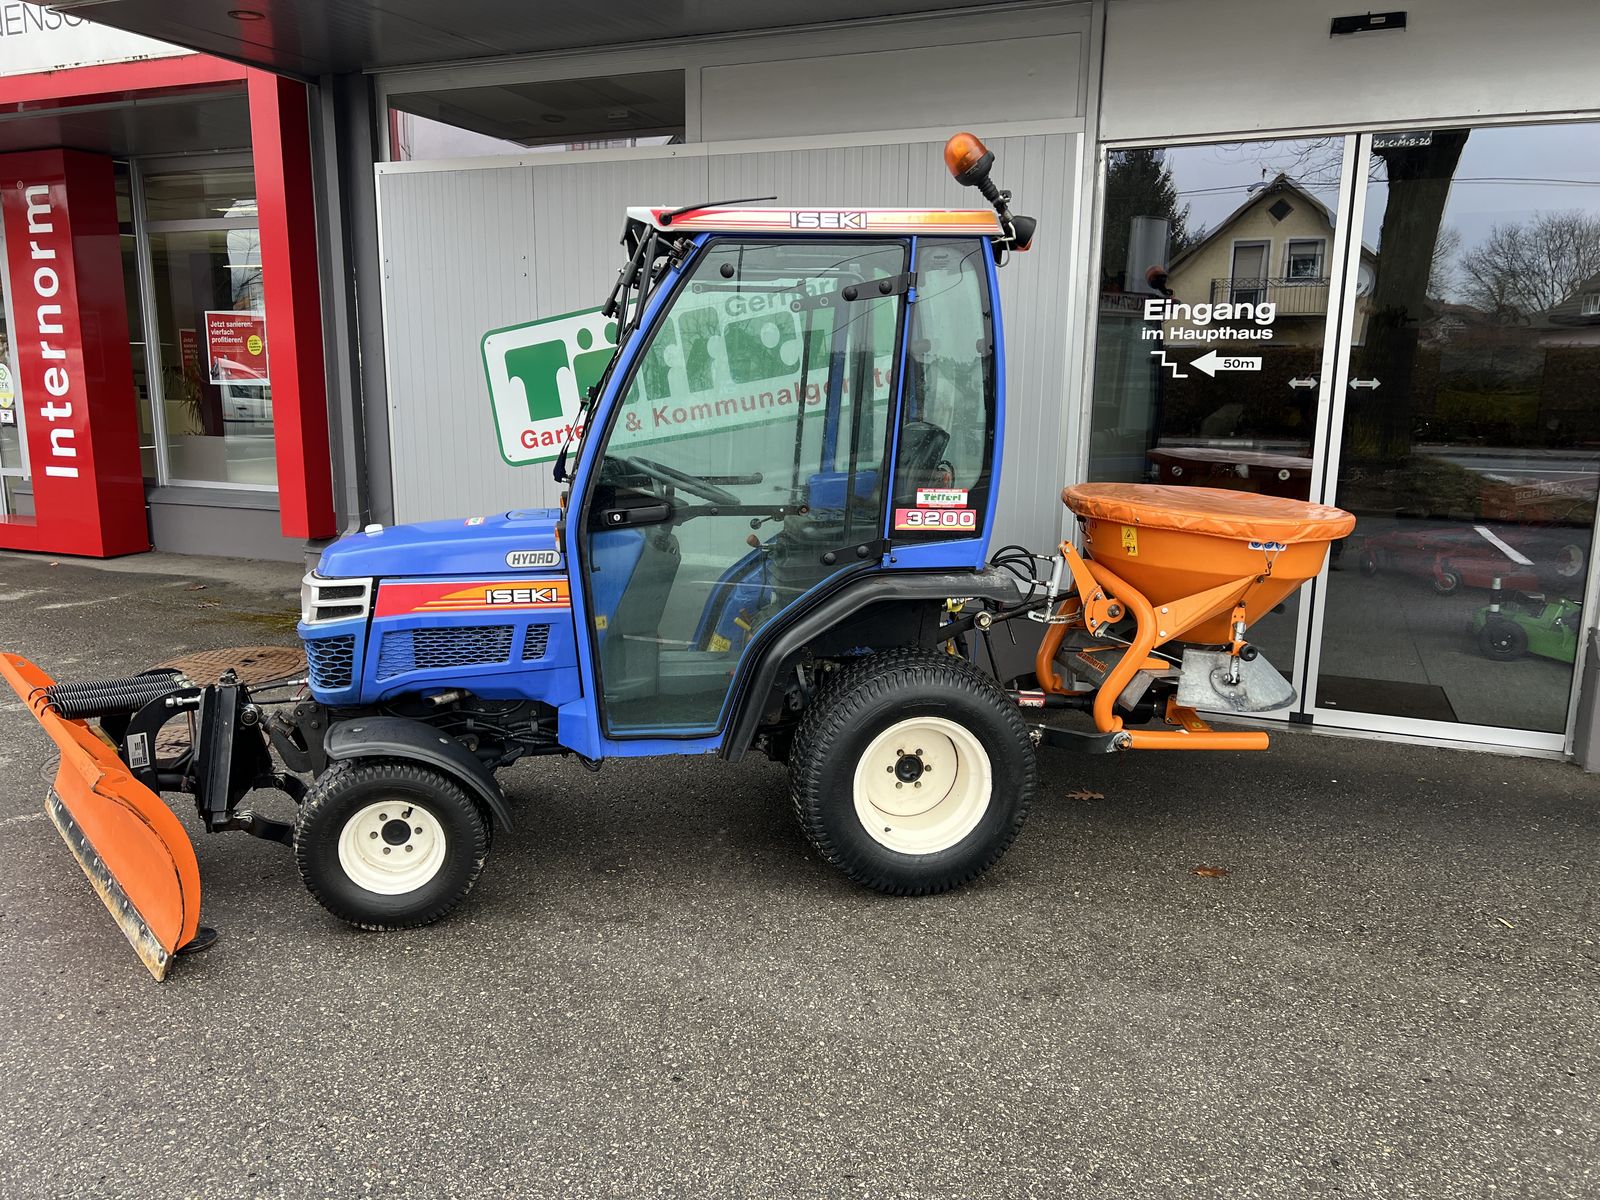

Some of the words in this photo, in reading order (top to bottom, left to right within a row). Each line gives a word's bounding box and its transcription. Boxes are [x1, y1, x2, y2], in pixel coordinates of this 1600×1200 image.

[790, 211, 867, 229] ISEKI
[725, 279, 838, 316] Gerhar
[1144, 299, 1276, 325] Eingang
[25, 184, 79, 478] Internorm
[1141, 327, 1164, 339] im
[1170, 327, 1273, 342] Haupthaus
[1223, 359, 1255, 369] 50m
[520, 423, 584, 450] Garte
[625, 411, 643, 432] &
[653, 365, 892, 428] Kommunalgrte
[906, 511, 975, 526] 3200
[512, 553, 554, 565] HYDRO
[485, 588, 558, 604] ISEKI
